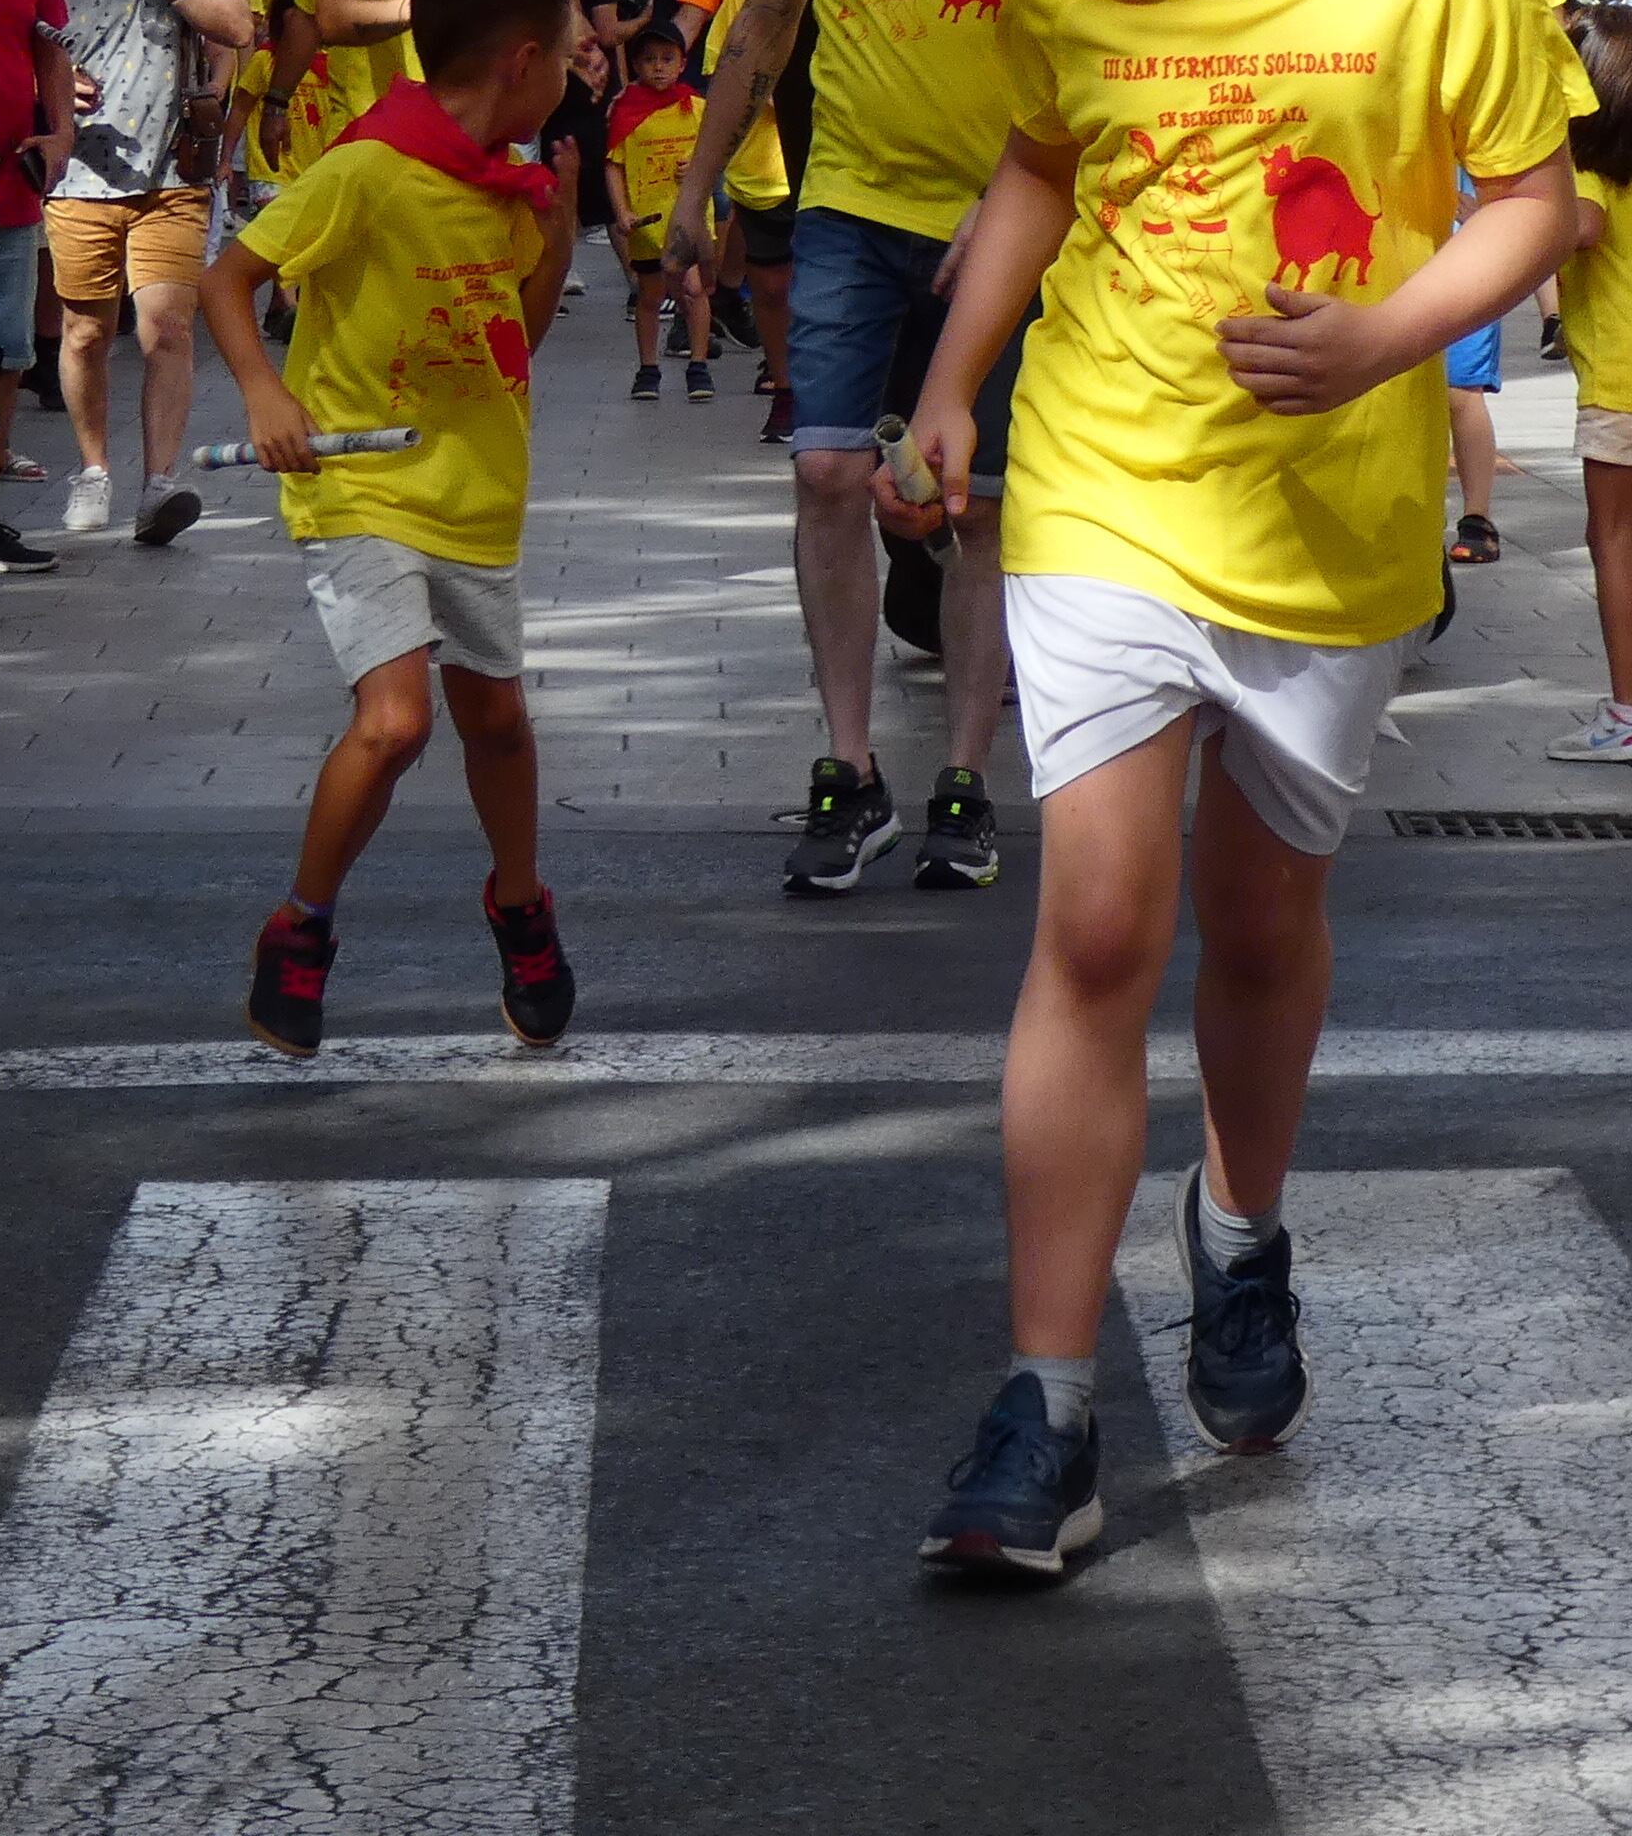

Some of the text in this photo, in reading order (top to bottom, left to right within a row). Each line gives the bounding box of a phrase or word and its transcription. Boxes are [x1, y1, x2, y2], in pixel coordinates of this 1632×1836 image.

[1103, 50, 1378, 81] III SAN FERMINES SOLIDARIOS
[1208, 82, 1257, 106] ELDA
[1158, 111, 1178, 129] EN
[1180, 108, 1255, 129] BENEFICIO
[1257, 108, 1277, 125] DE
